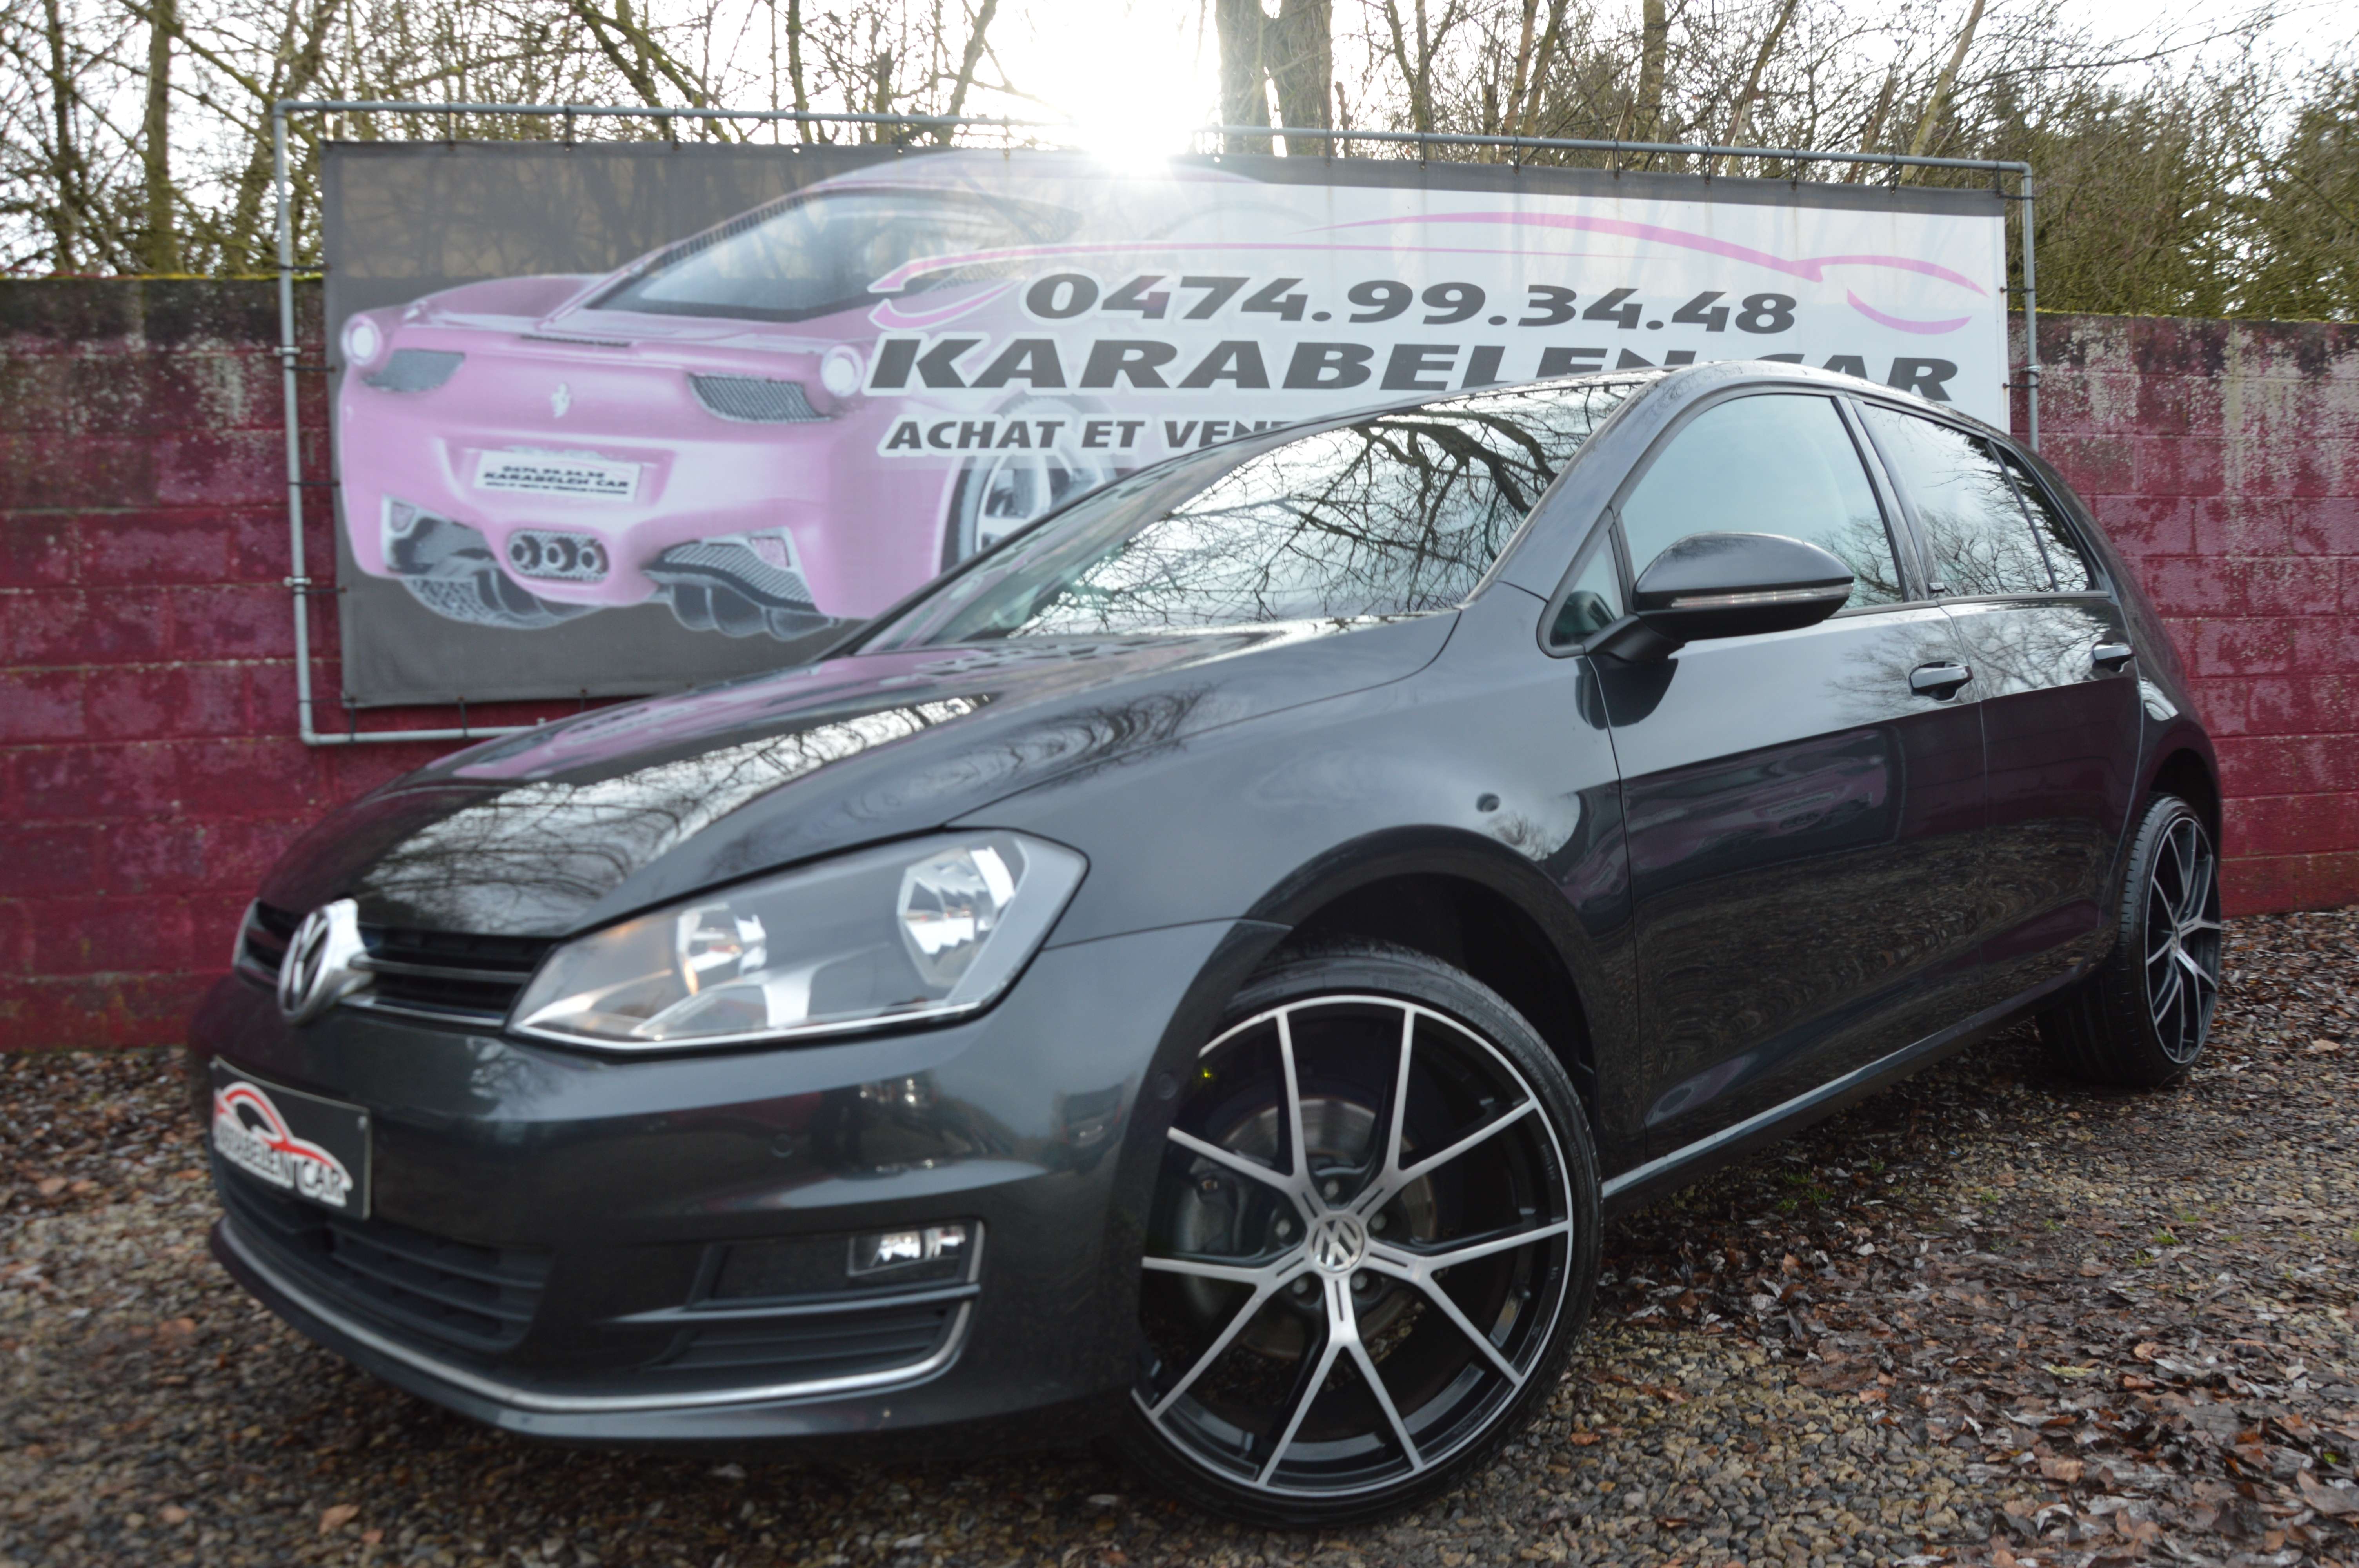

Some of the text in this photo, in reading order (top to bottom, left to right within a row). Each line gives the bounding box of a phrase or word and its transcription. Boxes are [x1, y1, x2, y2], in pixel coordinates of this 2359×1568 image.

[1026, 273, 1797, 335] 0474.99.34.48
[886, 420, 1296, 450] ACHAT ET VE
[295, 1151, 350, 1200] CAR
